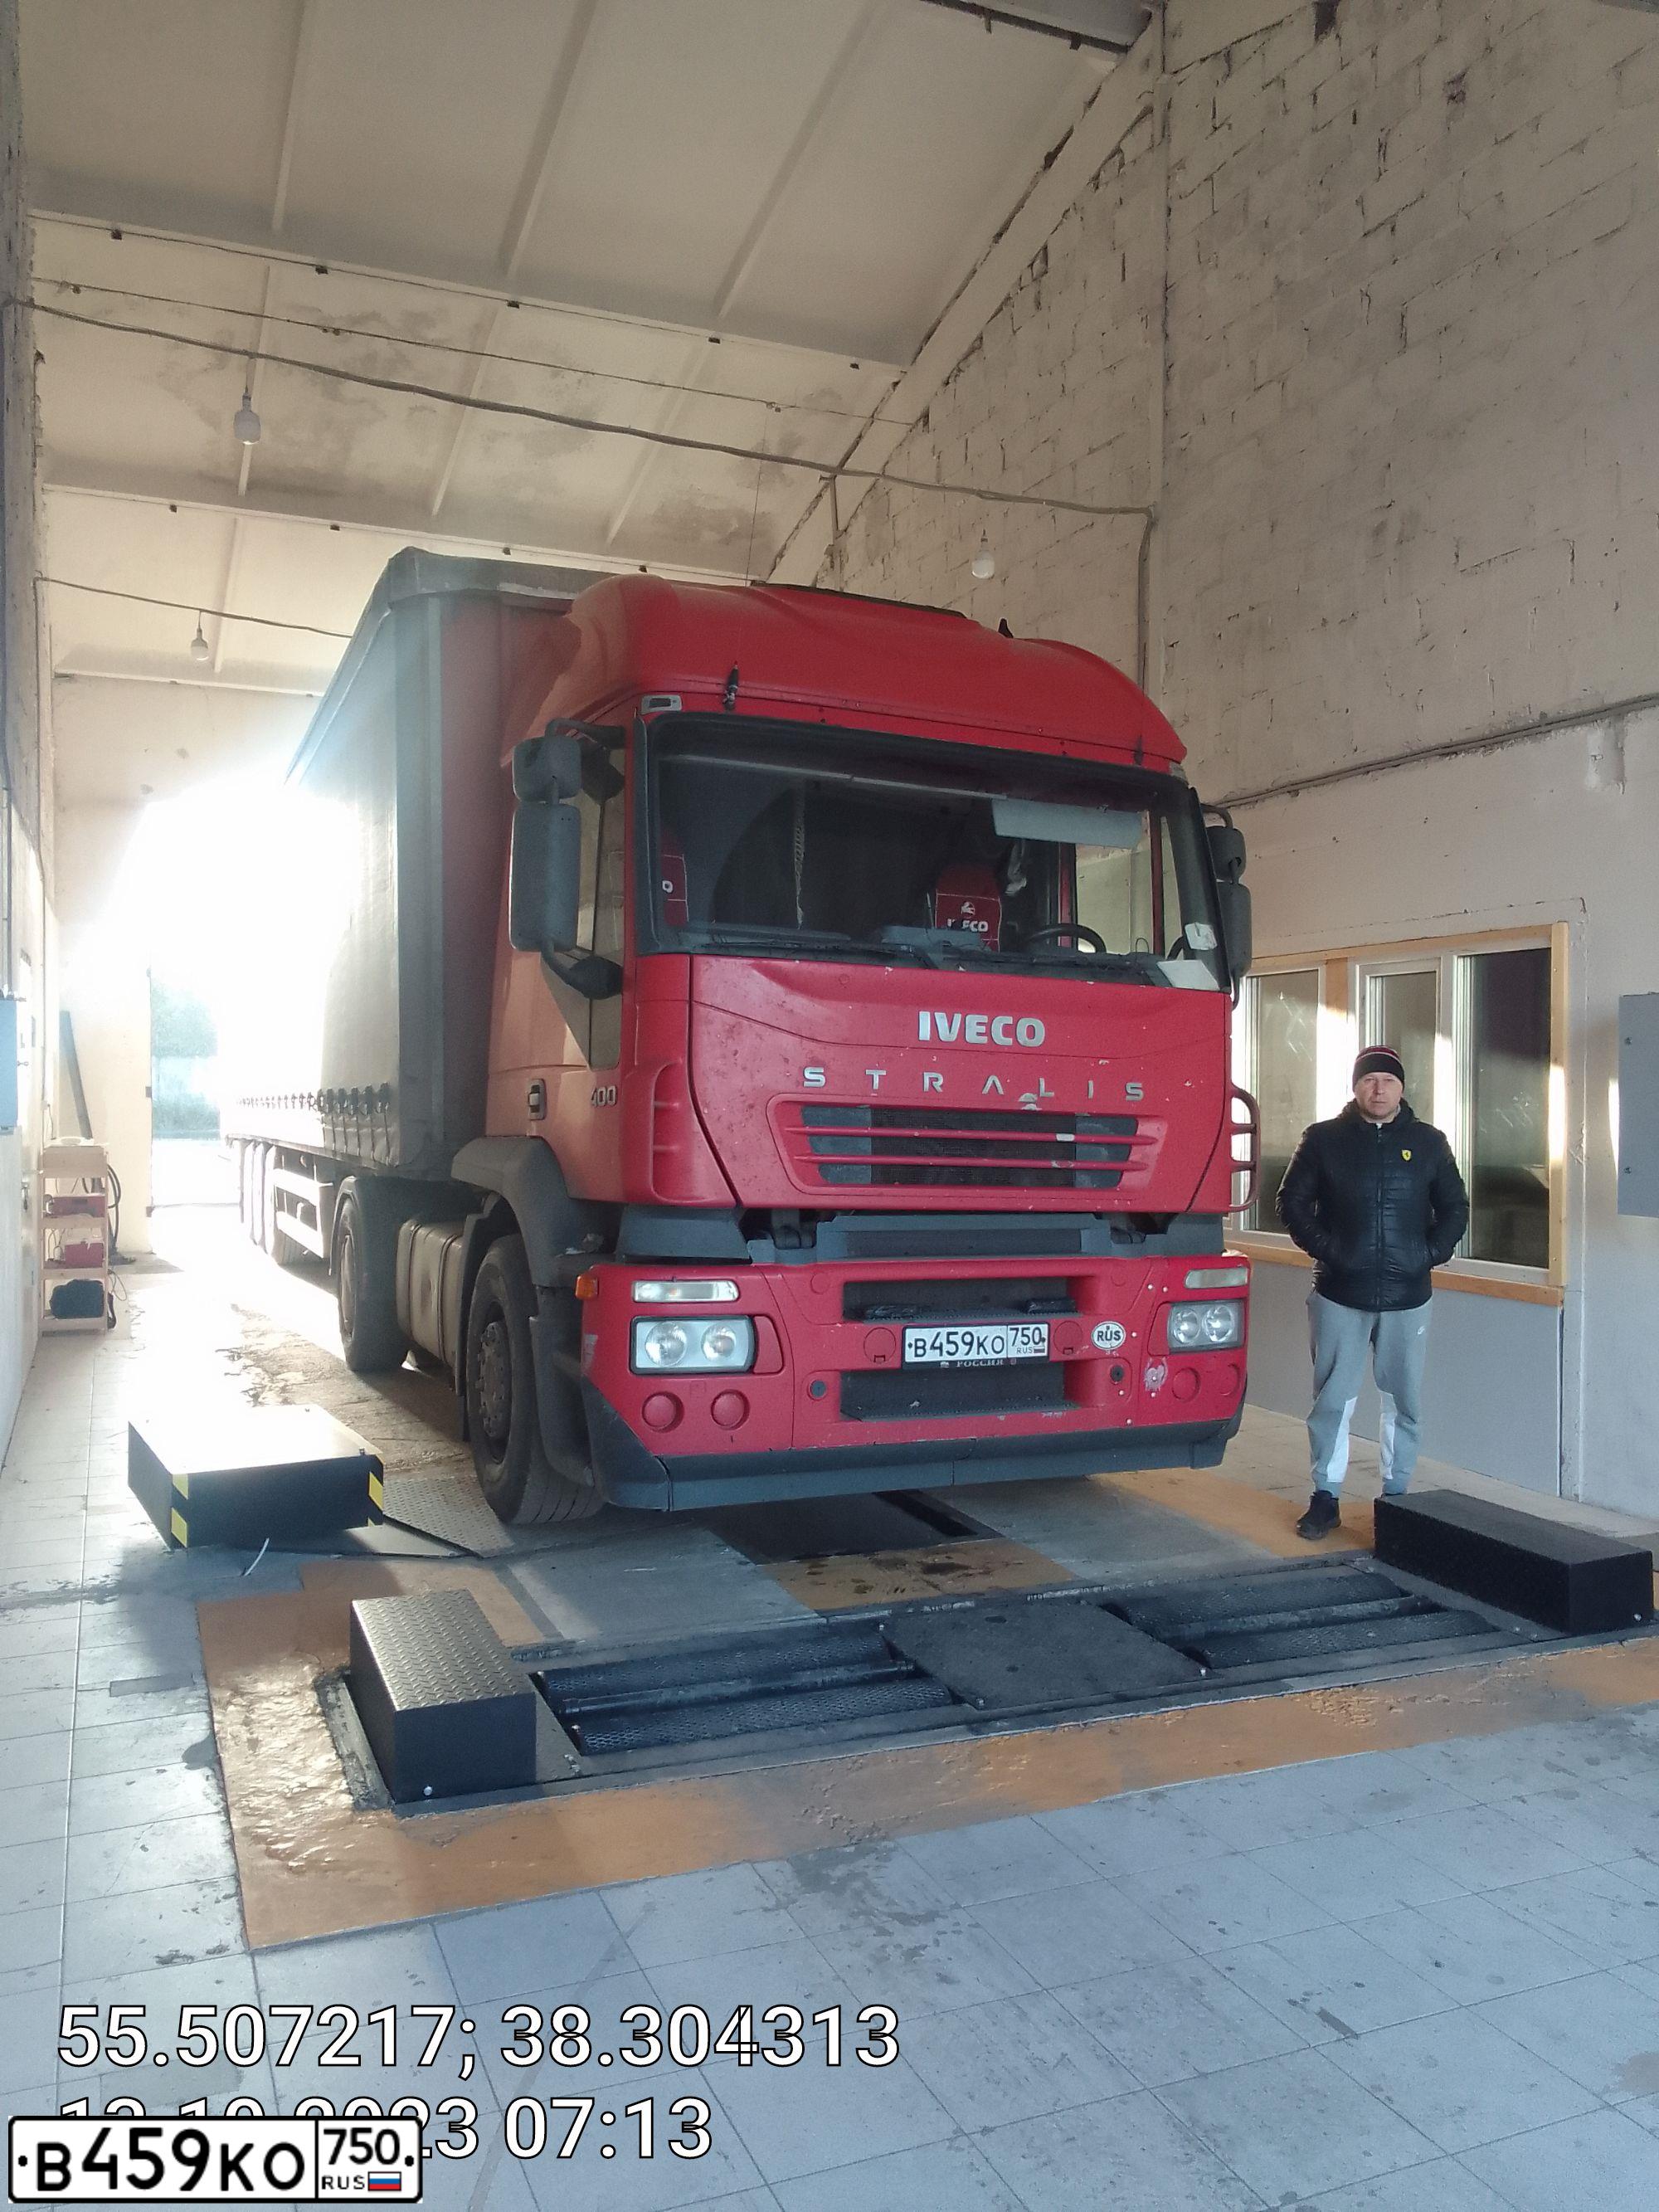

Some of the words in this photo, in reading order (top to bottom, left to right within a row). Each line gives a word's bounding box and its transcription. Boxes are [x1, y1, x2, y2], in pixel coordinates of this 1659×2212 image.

[917, 1011, 1046, 1048] IVECO
[802, 1065, 1146, 1102] STRALIS
[1009, 1327, 1043, 1347] 750
[1096, 1329, 1121, 1342] RUS
